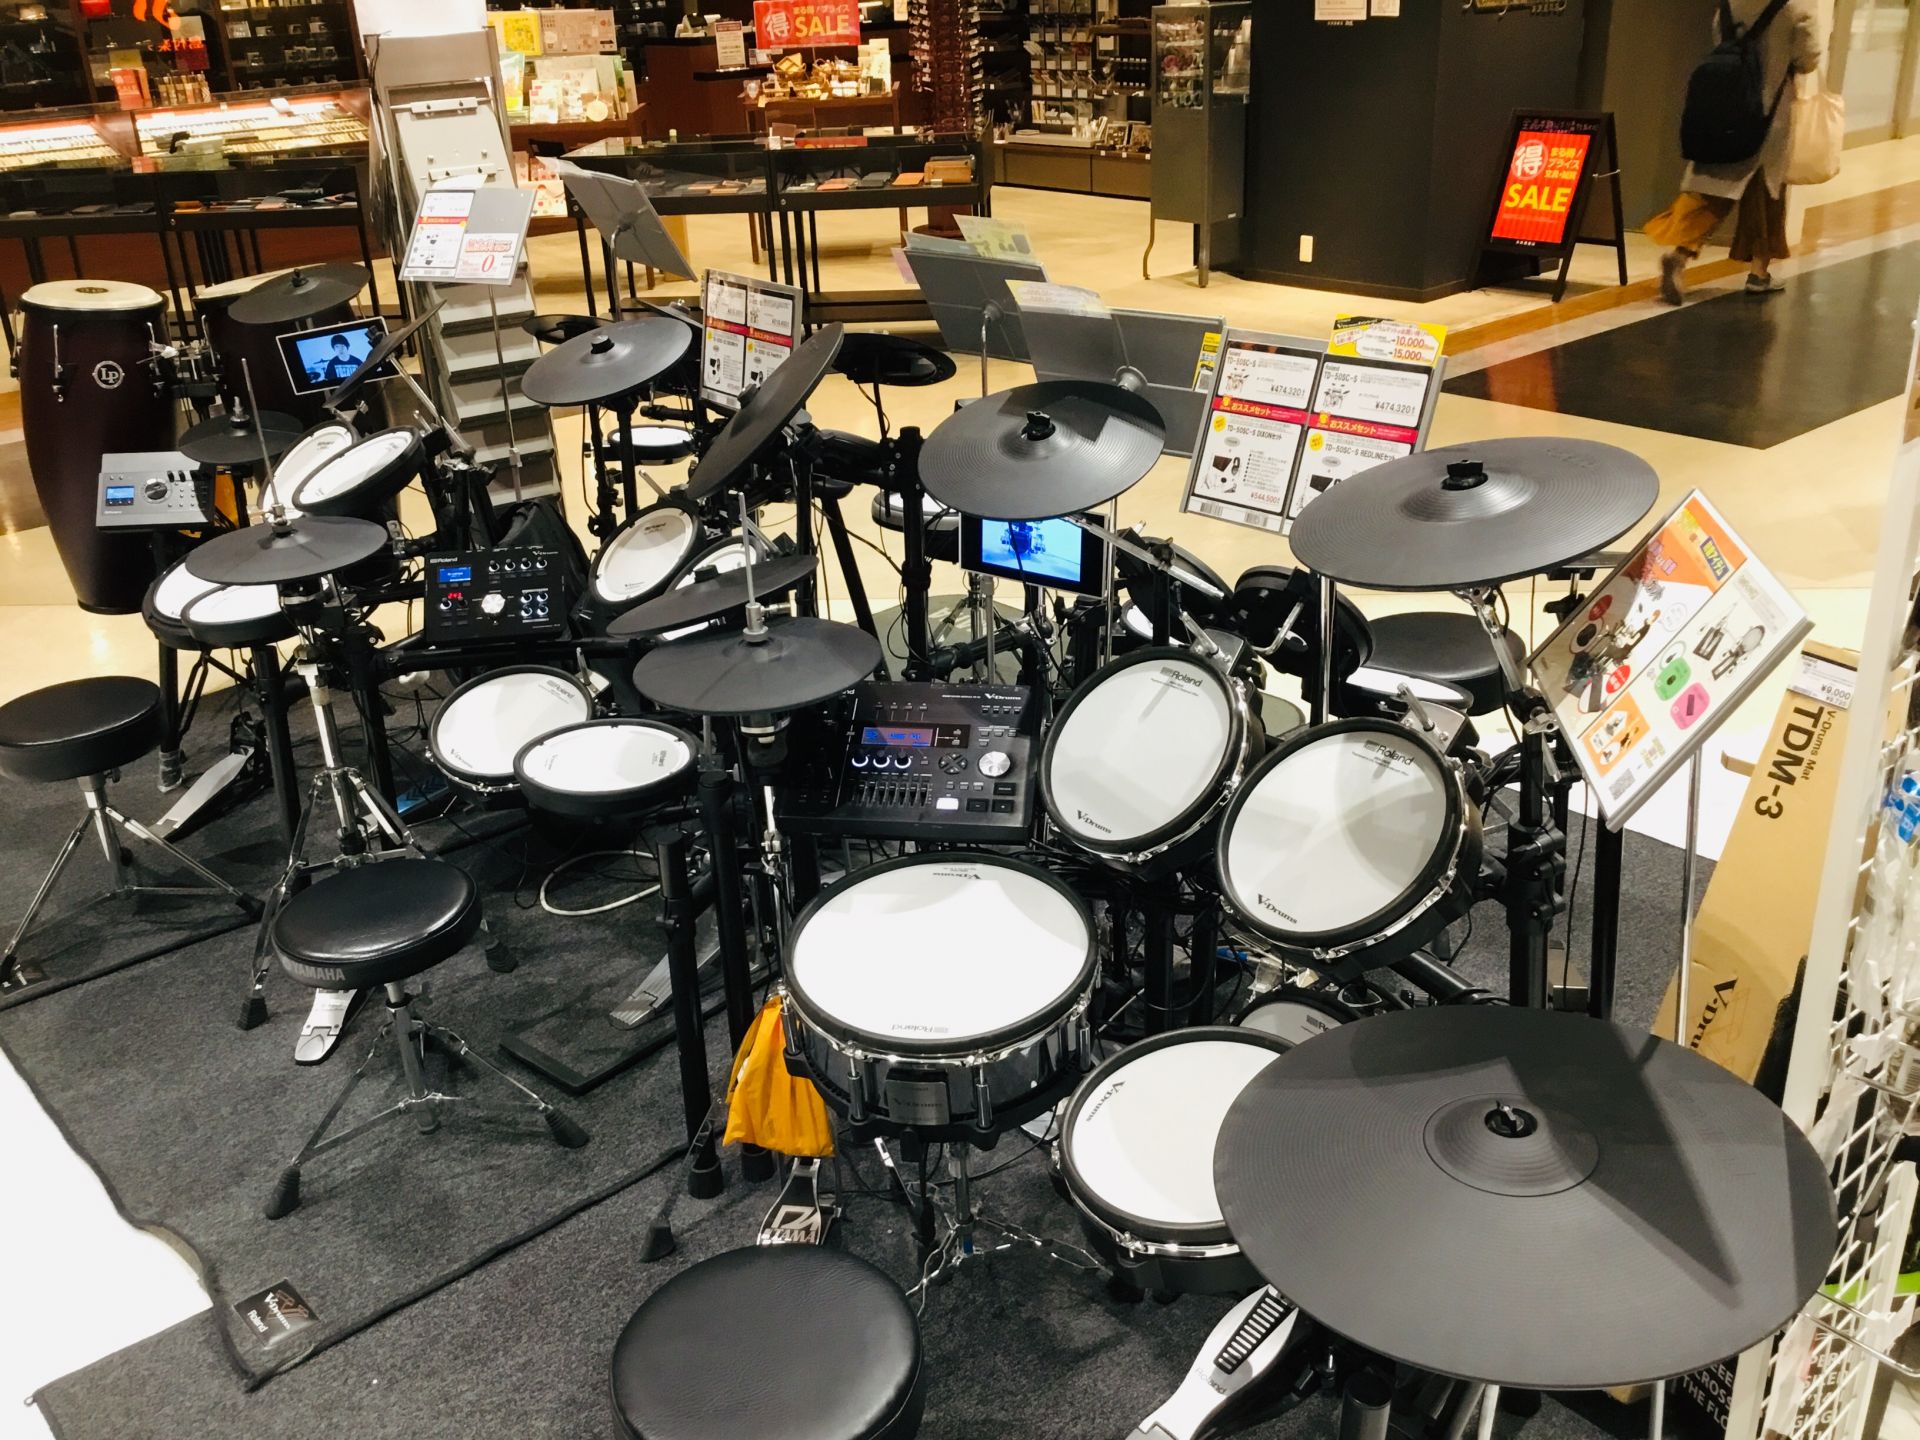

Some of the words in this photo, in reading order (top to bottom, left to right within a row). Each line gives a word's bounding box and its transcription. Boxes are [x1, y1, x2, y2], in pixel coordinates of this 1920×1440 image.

[764, 12, 790, 41] 得
[795, 14, 850, 38] SALE
[1515, 144, 1543, 177] 得
[1504, 183, 1572, 212] SALE
[100, 367, 119, 383] LP
[1171, 670, 1203, 688] Roland
[1811, 709, 1837, 757] V-Drums
[1376, 744, 1415, 766] Roland
[1754, 706, 1825, 820] TDM-3
[1801, 759, 1817, 781] Mat
[1077, 809, 1112, 834] V-Drums
[1258, 893, 1297, 924] V-Drums
[891, 1024, 933, 1033] Roland
[1086, 1080, 1126, 1122] V-Drums
[771, 1228, 816, 1243] TAMA
[247, 1309, 269, 1333] Roland
[264, 1292, 291, 1330] V-Drums
[1683, 1374, 1706, 1407] THE
